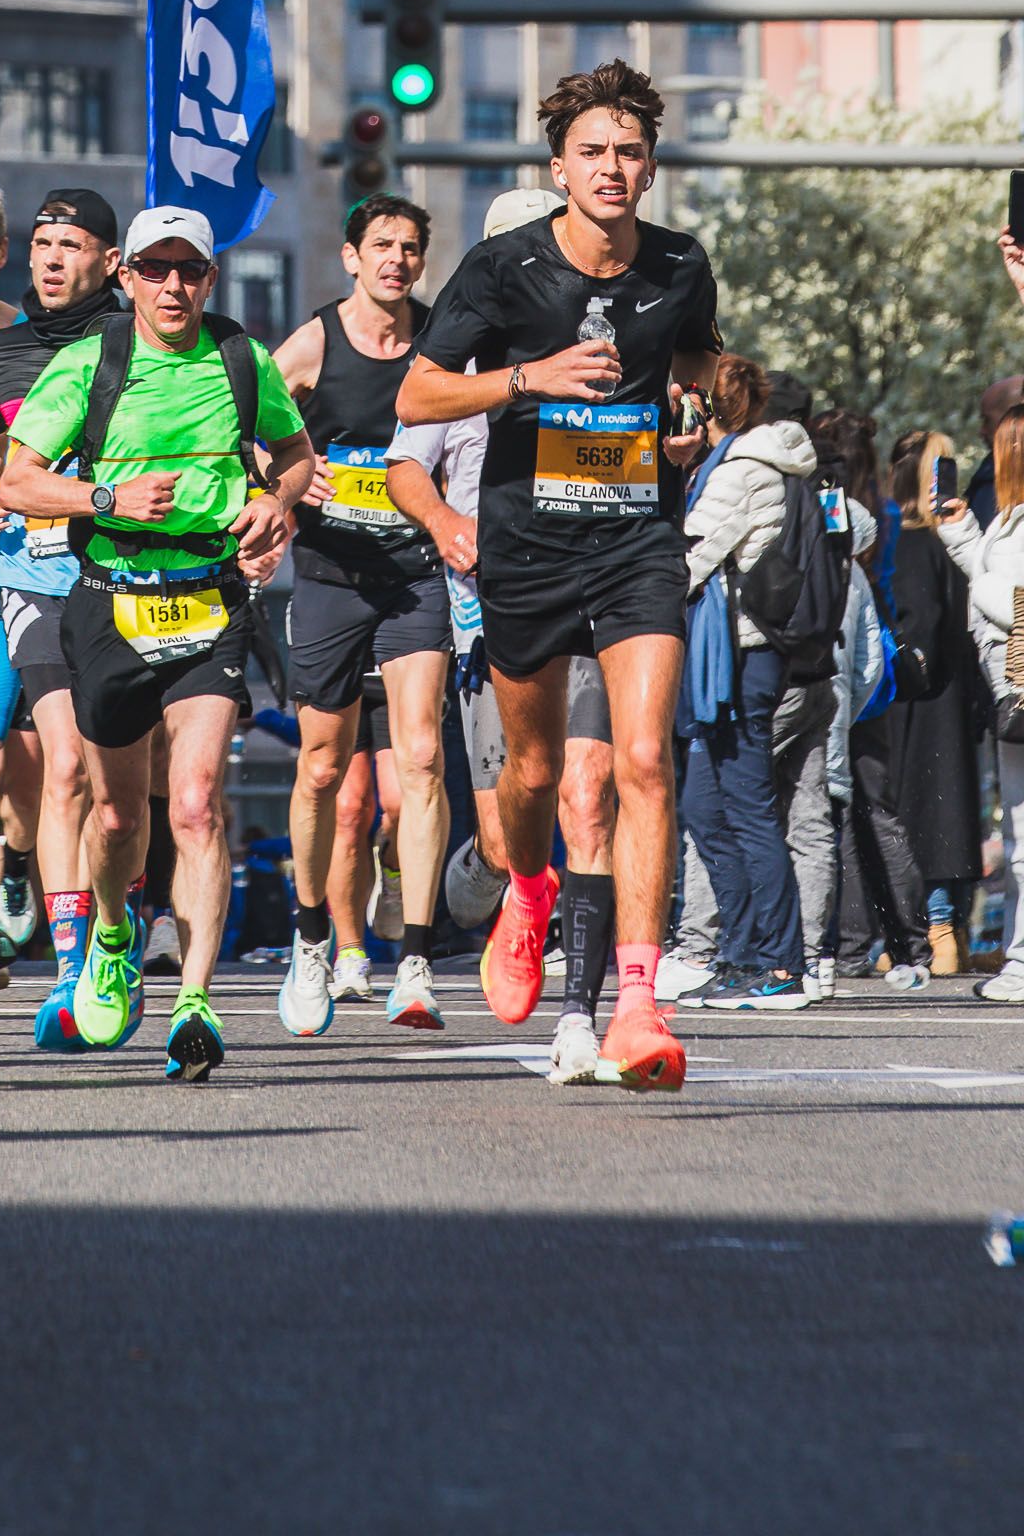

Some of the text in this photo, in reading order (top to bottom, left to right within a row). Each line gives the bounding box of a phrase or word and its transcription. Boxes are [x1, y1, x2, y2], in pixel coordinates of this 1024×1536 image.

[597, 412, 641, 424] movistar
[576, 446, 624, 467] 5638
[356, 479, 389, 496] 147
[565, 483, 632, 499] CELANOVA
[348, 507, 398, 523] TRUJILLO
[148, 604, 189, 623] 1581
